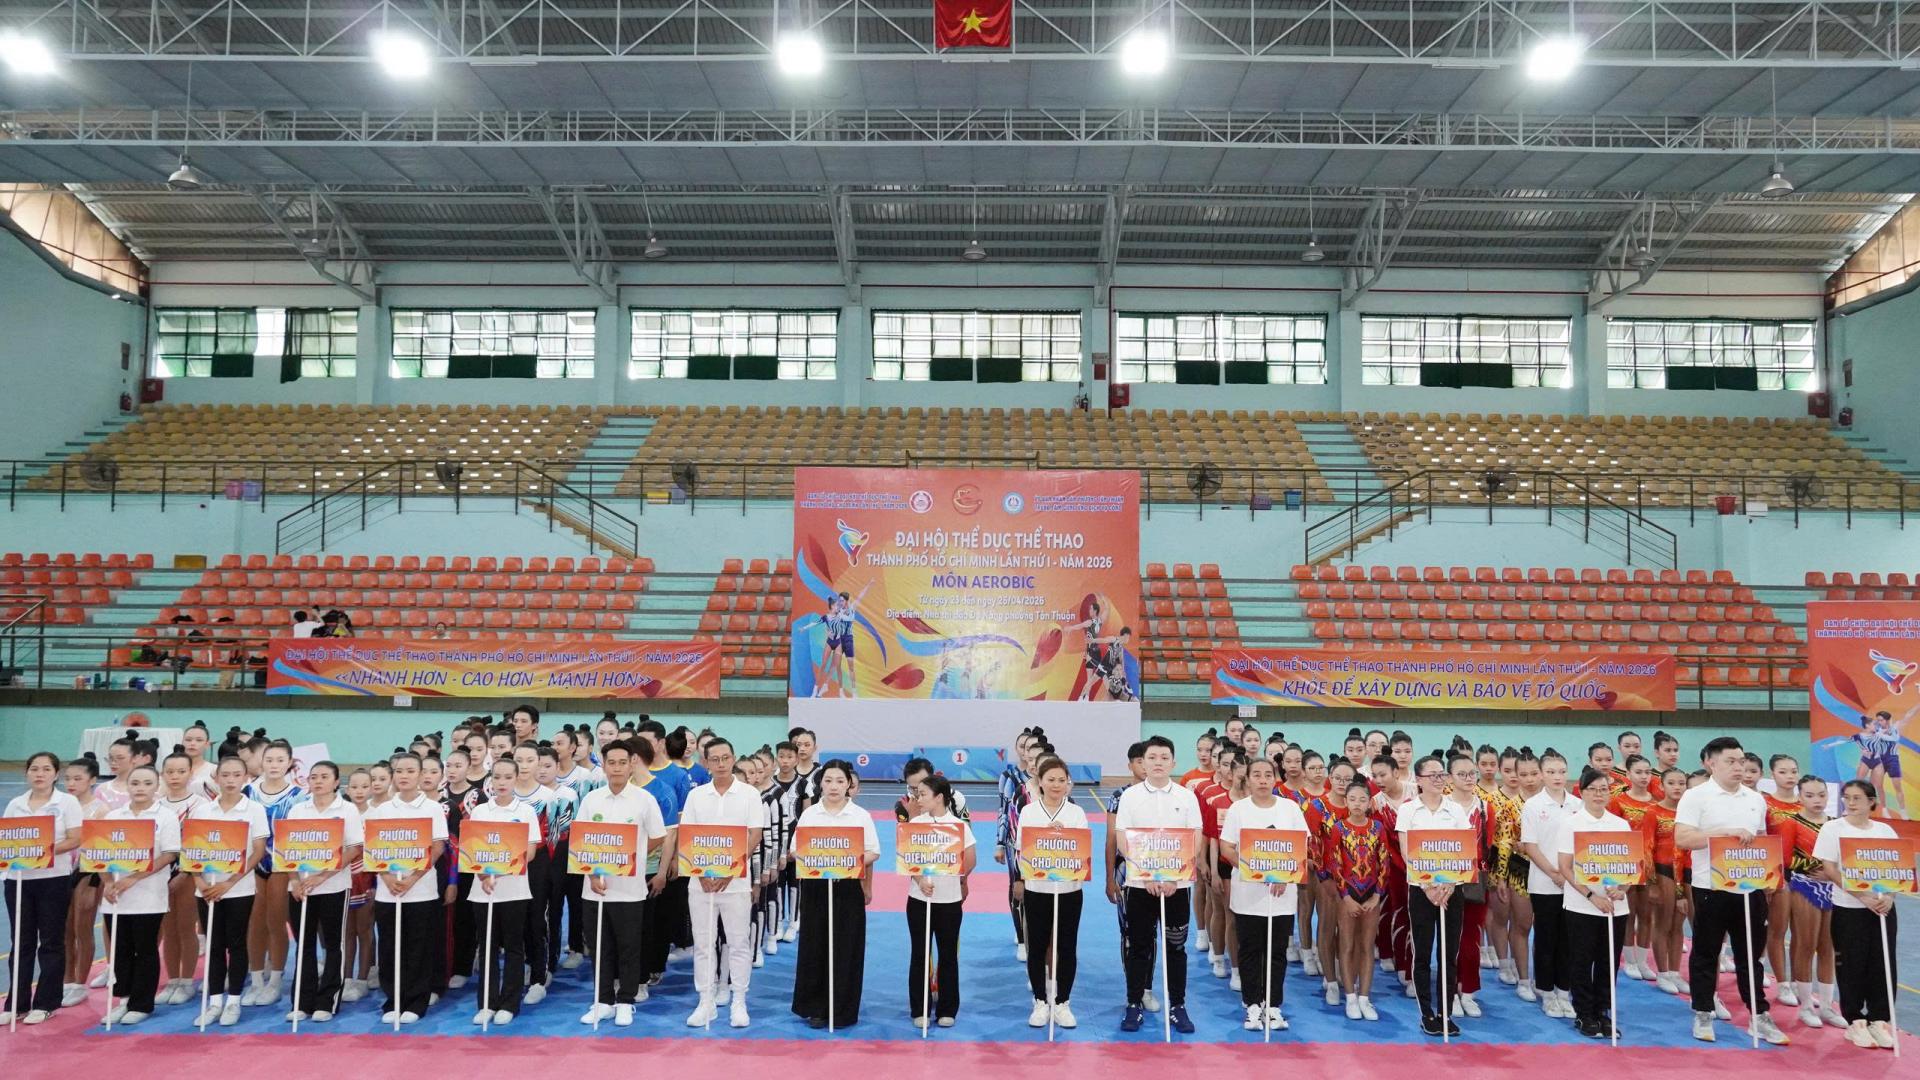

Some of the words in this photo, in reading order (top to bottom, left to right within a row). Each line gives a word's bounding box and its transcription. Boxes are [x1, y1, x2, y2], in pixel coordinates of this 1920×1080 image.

[895, 531, 920, 552] ĐẠI
[924, 527, 948, 552] HỘI
[952, 525, 980, 549] THỂ
[982, 532, 1011, 552] DỤC
[1014, 525, 1043, 549] THỂ
[1044, 533, 1084, 549] THAO
[866, 552, 903, 566] THÀNH
[907, 550, 929, 567] PHỐ
[930, 550, 946, 567] HỒ
[950, 551, 967, 567] CHÍ
[968, 555, 997, 567] MINH
[1000, 551, 1021, 568] LẦN
[1023, 551, 1046, 568] THỨ
[1060, 553, 1084, 568] NĂM
[1087, 557, 1113, 569] 2026
[932, 571, 967, 588] MÔN
[972, 575, 1035, 589] AEROBIC
[308, 647, 328, 664] HỘI
[406, 651, 436, 662] THAO
[439, 648, 477, 662] THÀNH
[480, 647, 504, 662] PHỐ
[549, 652, 578, 663] MINH
[674, 652, 703, 664] 2026
[1230, 658, 1249, 673] ĐẠI
[1252, 656, 1273, 673] HỘI
[1277, 655, 1298, 671] THỂ
[1328, 656, 1350, 671] THỂ
[1352, 662, 1384, 672] THAO
[1388, 658, 1426, 672] THÀNH
[1430, 657, 1454, 673] PHỐ
[1457, 657, 1474, 673] HỒ
[1500, 663, 1530, 674] MINH
[1533, 658, 1555, 674] LẦN
[1628, 664, 1657, 675] 2026
[411, 669, 448, 686] HƠN
[462, 671, 493, 686] CAO
[498, 671, 535, 687] HƠN
[548, 672, 598, 689] MẠNH
[1282, 676, 1330, 696] KHỎE
[1332, 675, 1356, 696] ĐỂ
[1358, 678, 1391, 697] XÂY
[1394, 681, 1442, 700] DỰNG
[1448, 678, 1467, 698] VÀ
[1473, 678, 1506, 698] BẢO
[1512, 681, 1532, 701] VỆ
[1536, 677, 1557, 698] TỔ
[1559, 677, 1606, 700] QUỐC
[859, 757, 867, 765] 2
[957, 753, 963, 763] 1
